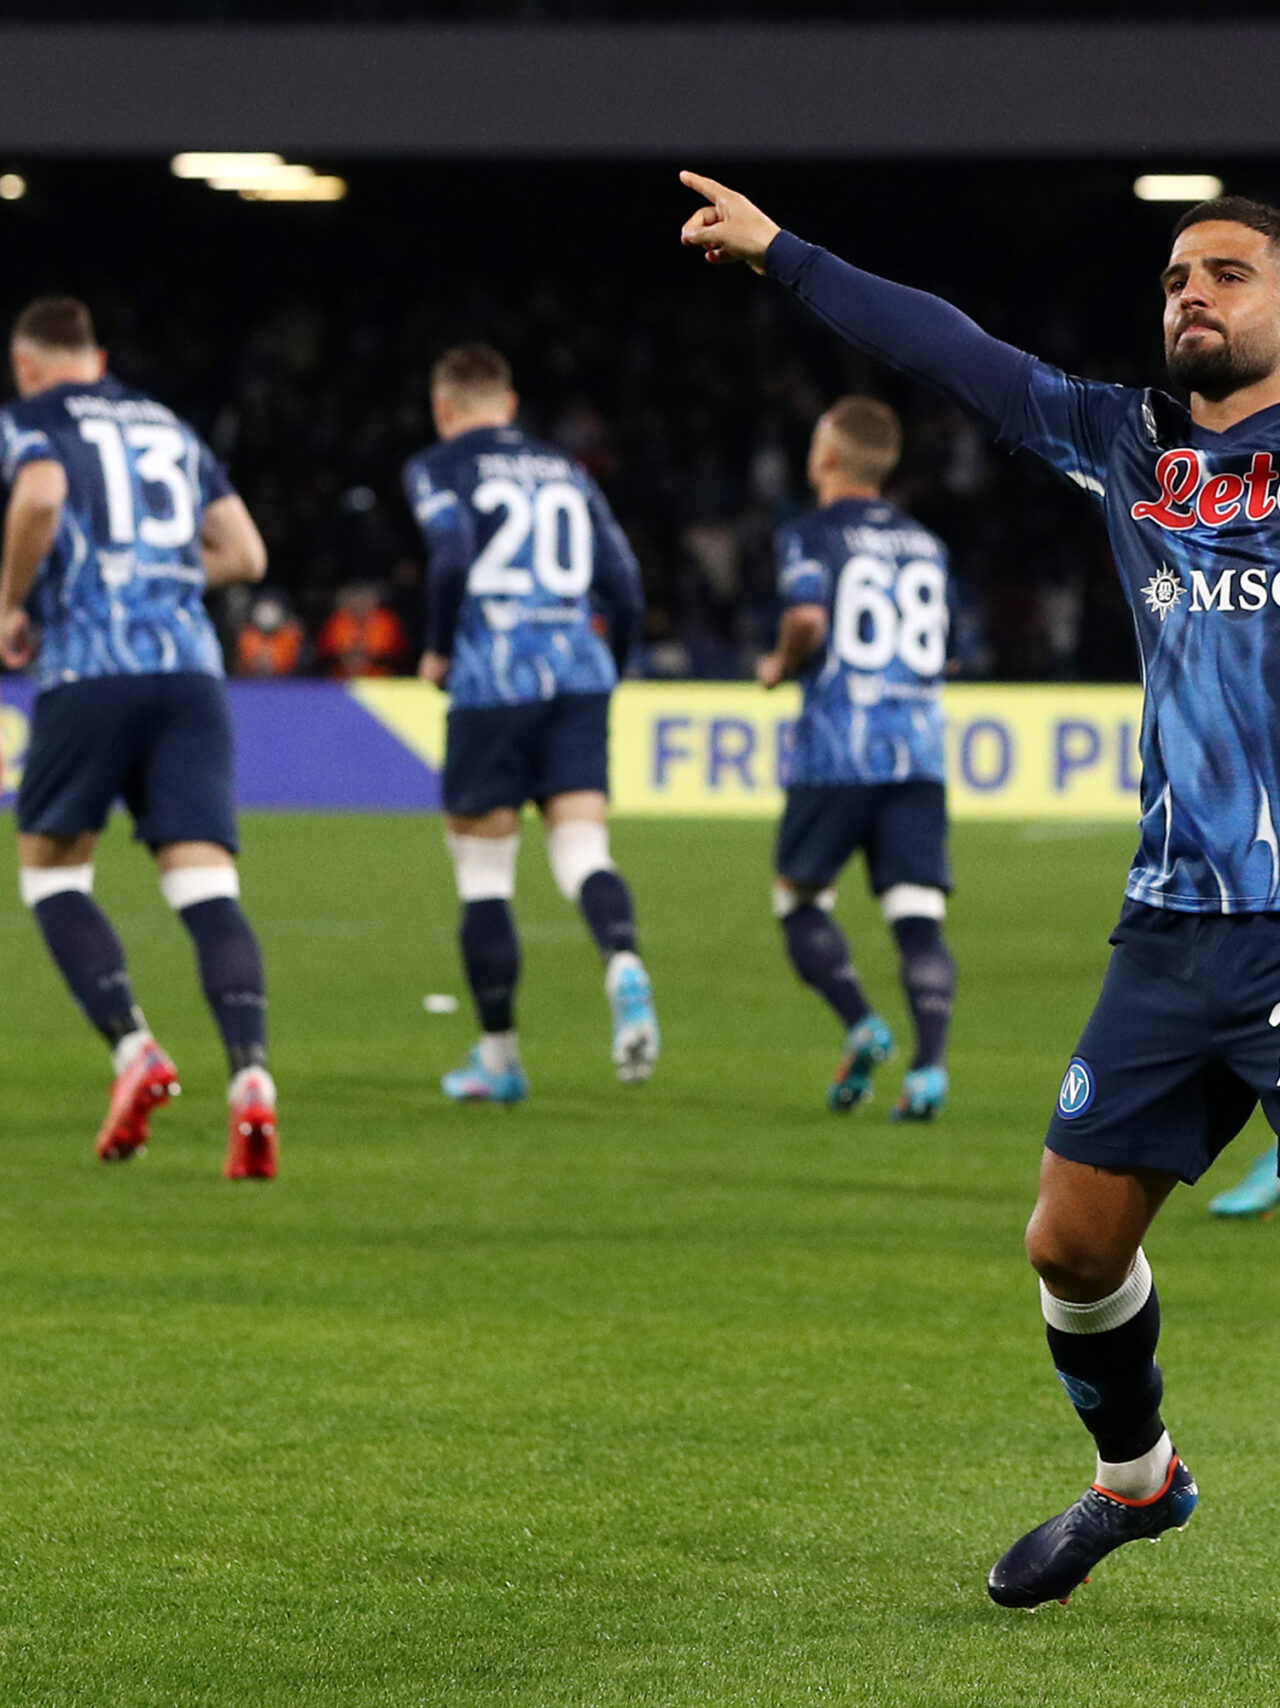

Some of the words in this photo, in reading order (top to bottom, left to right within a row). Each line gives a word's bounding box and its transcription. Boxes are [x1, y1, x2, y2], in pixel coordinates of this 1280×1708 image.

[79, 418, 193, 547] 13
[467, 477, 594, 596] 20
[834, 554, 950, 677] 68
[1062, 1071, 1084, 1105] N
